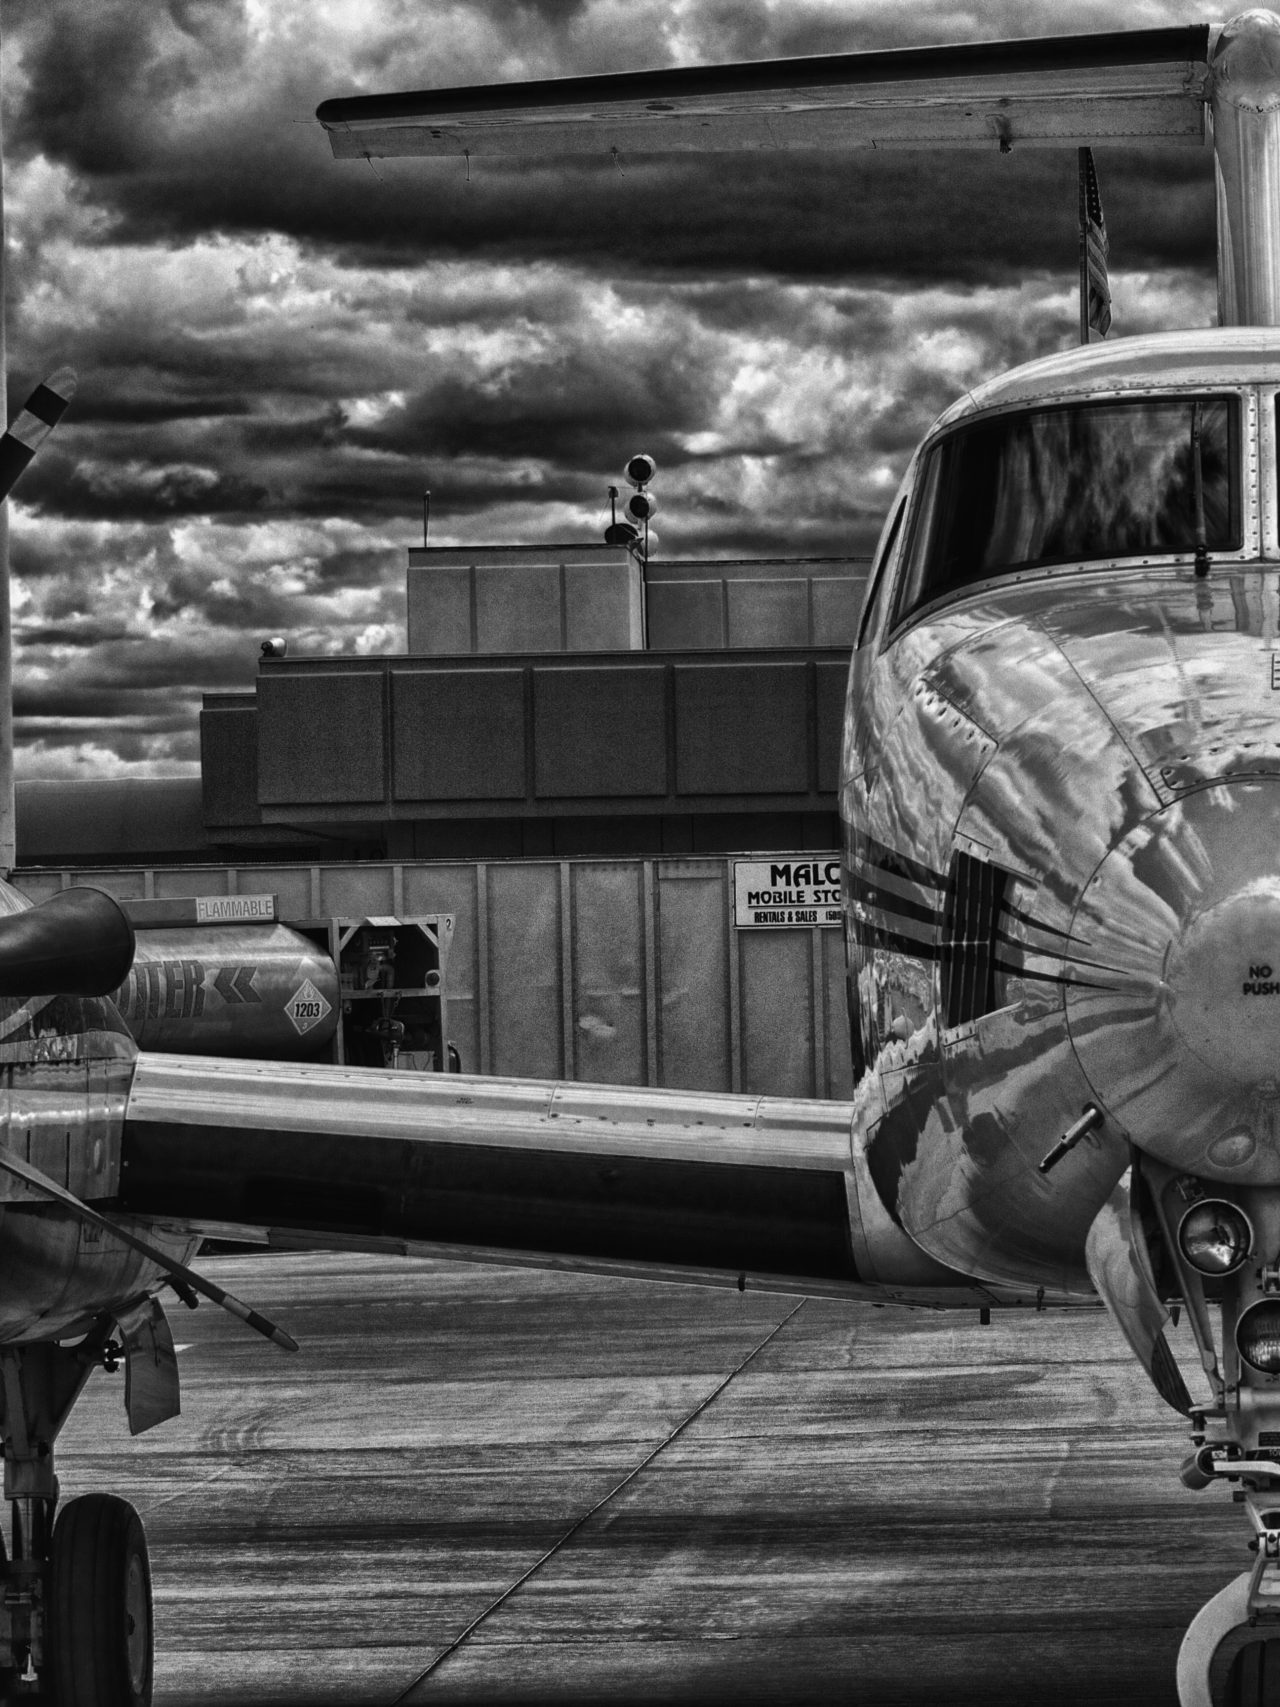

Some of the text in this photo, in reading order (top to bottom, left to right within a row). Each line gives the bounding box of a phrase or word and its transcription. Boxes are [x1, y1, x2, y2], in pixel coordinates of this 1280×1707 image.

[747, 890, 805, 904] MOBILE
[198, 900, 273, 917] FLAMMABLE
[754, 911, 785, 923] RENTALS
[787, 911, 793, 922] &
[795, 911, 817, 922] SALES
[1249, 965, 1273, 978] NO
[1243, 982, 1280, 995] PUSH
[295, 1003, 320, 1018] 1203
